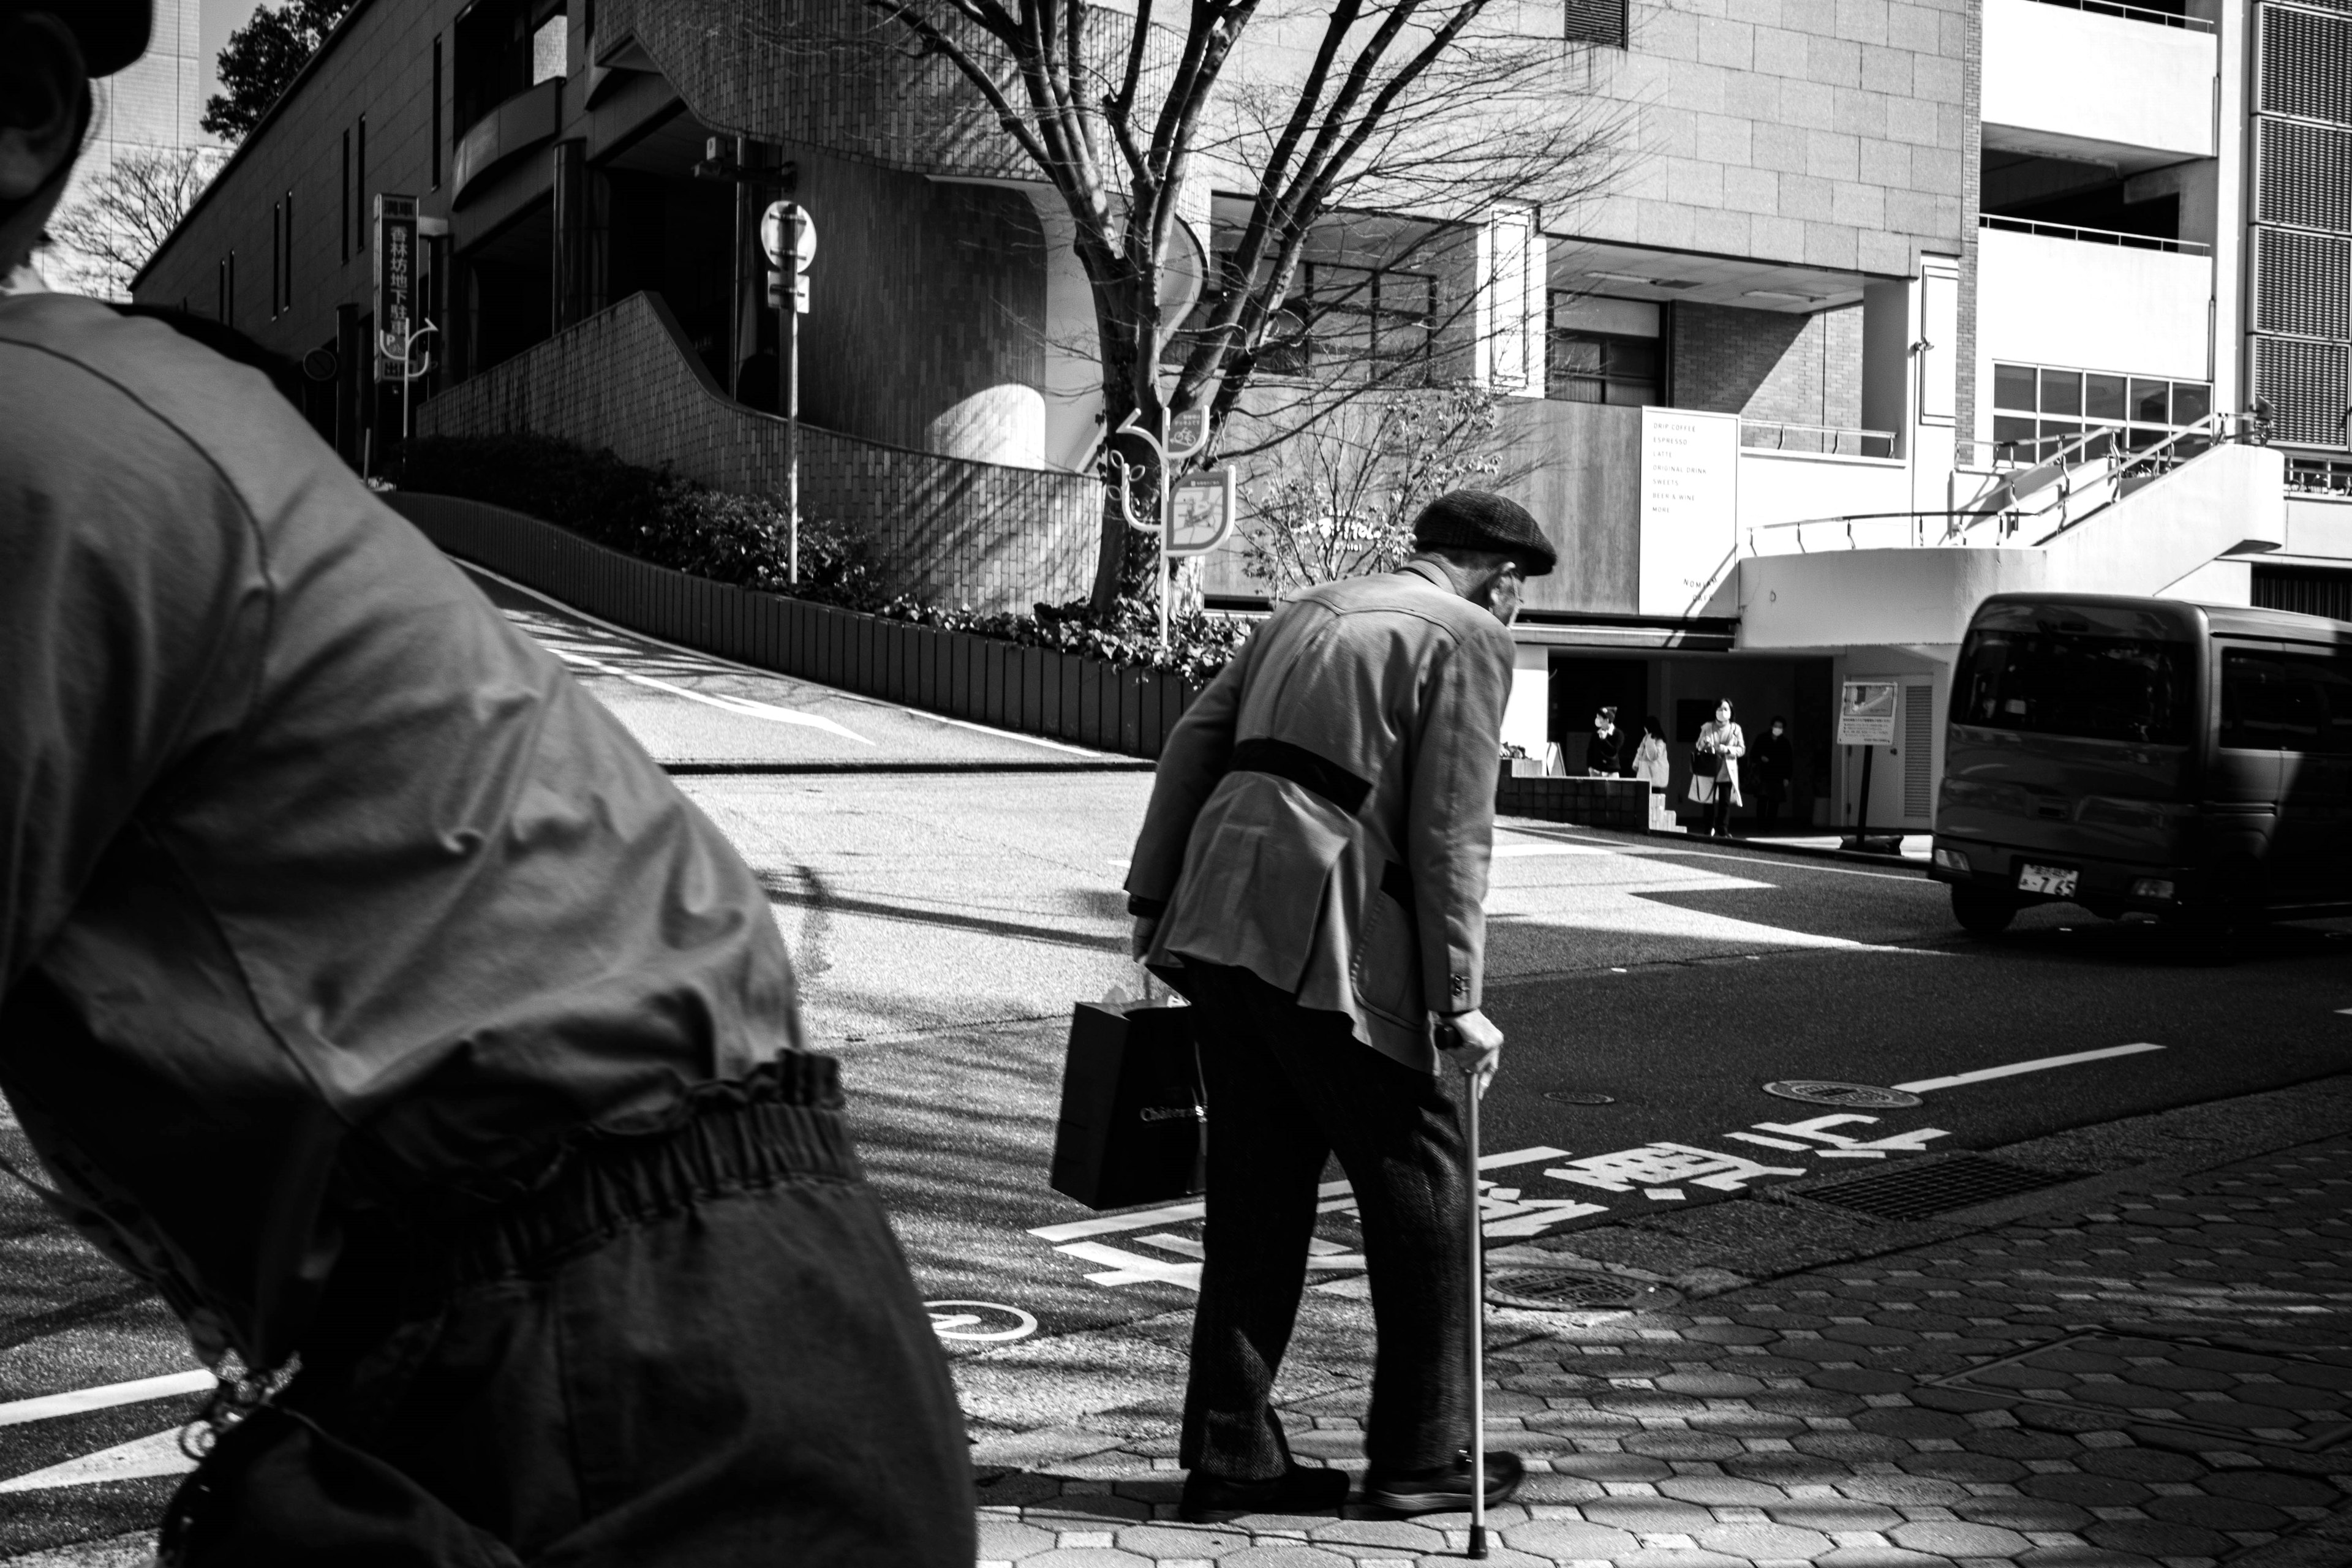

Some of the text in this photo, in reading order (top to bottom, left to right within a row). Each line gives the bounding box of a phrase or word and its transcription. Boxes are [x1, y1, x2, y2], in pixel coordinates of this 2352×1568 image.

[386, 334, 396, 347] P
[1672, 424, 1695, 432] COFFEE
[1653, 436, 1687, 445] ESPRESSO
[1653, 464, 1683, 473] ORIGINAL
